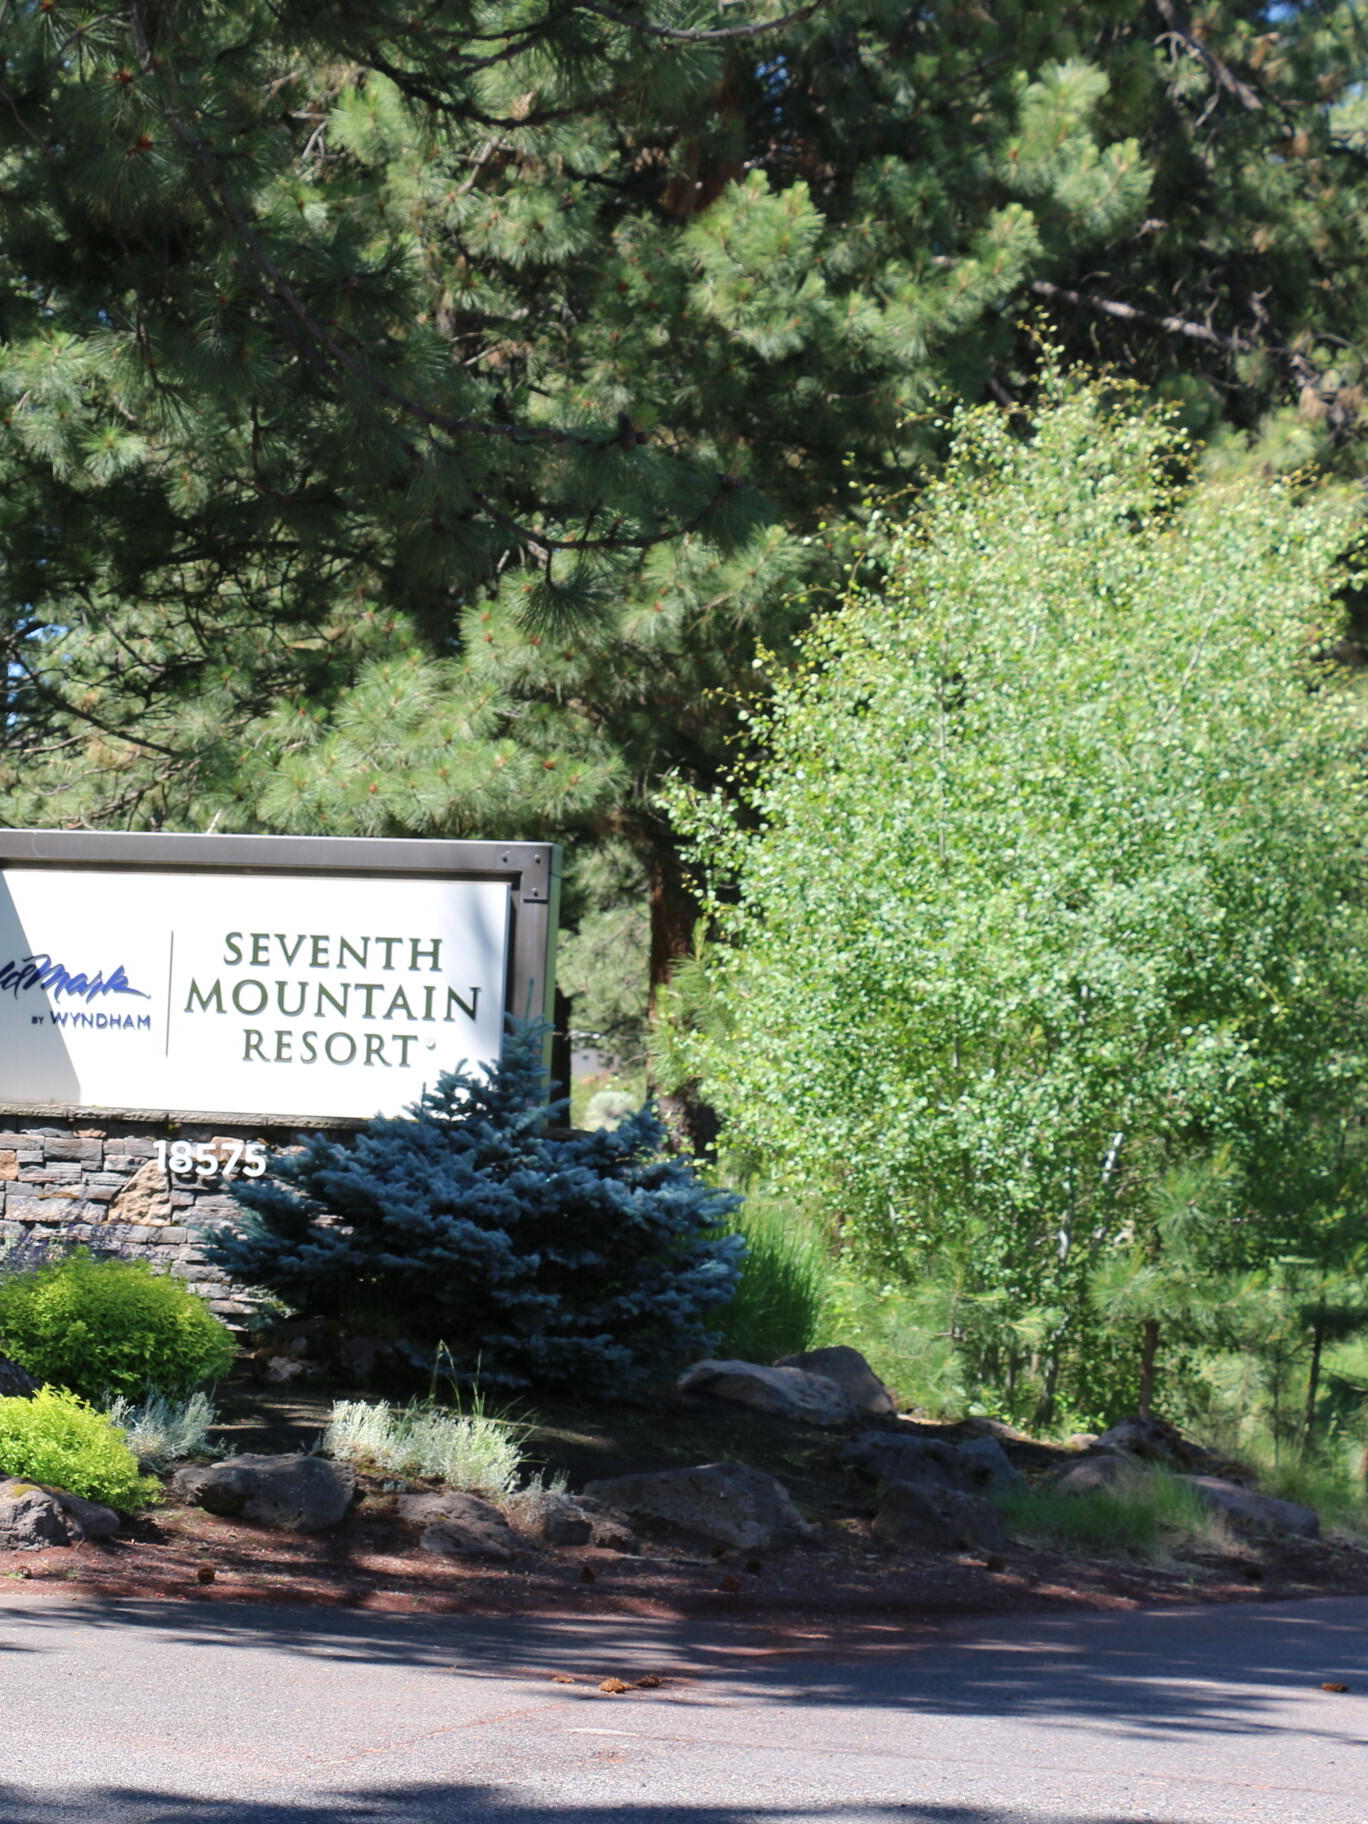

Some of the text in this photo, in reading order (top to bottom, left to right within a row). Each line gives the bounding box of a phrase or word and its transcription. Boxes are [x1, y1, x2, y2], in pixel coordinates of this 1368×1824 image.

[223, 932, 443, 972] SEVENTH
[183, 977, 481, 1023] MOUNTAIN
[31, 1010, 151, 1031] BY WYNDHAM
[242, 1029, 419, 1068] RESORT
[153, 1140, 266, 1177] 18575
